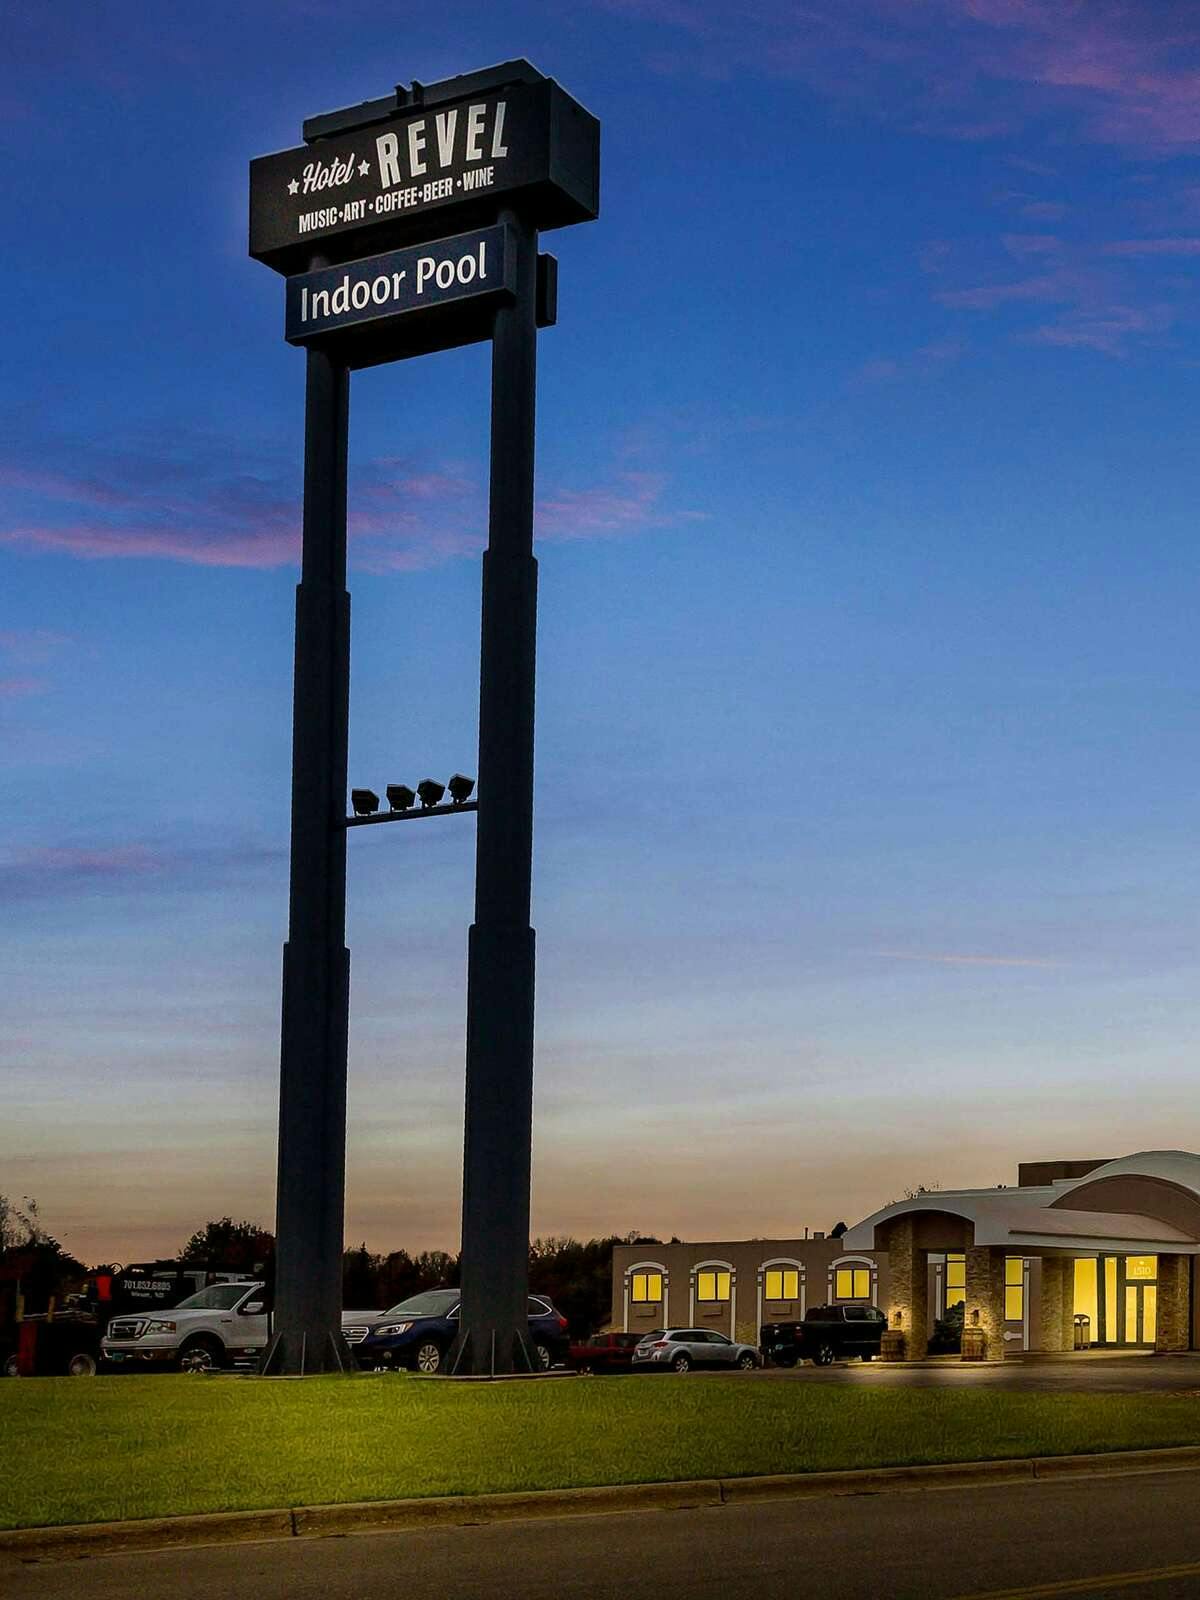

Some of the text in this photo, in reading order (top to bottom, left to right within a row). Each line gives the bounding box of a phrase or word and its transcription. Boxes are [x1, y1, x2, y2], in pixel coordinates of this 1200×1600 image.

[302, 101, 508, 195] Hotel REVEL
[298, 166, 495, 234] MUSIC ART COFFEE BEER WINE
[301, 241, 487, 322] Indoor Pool
